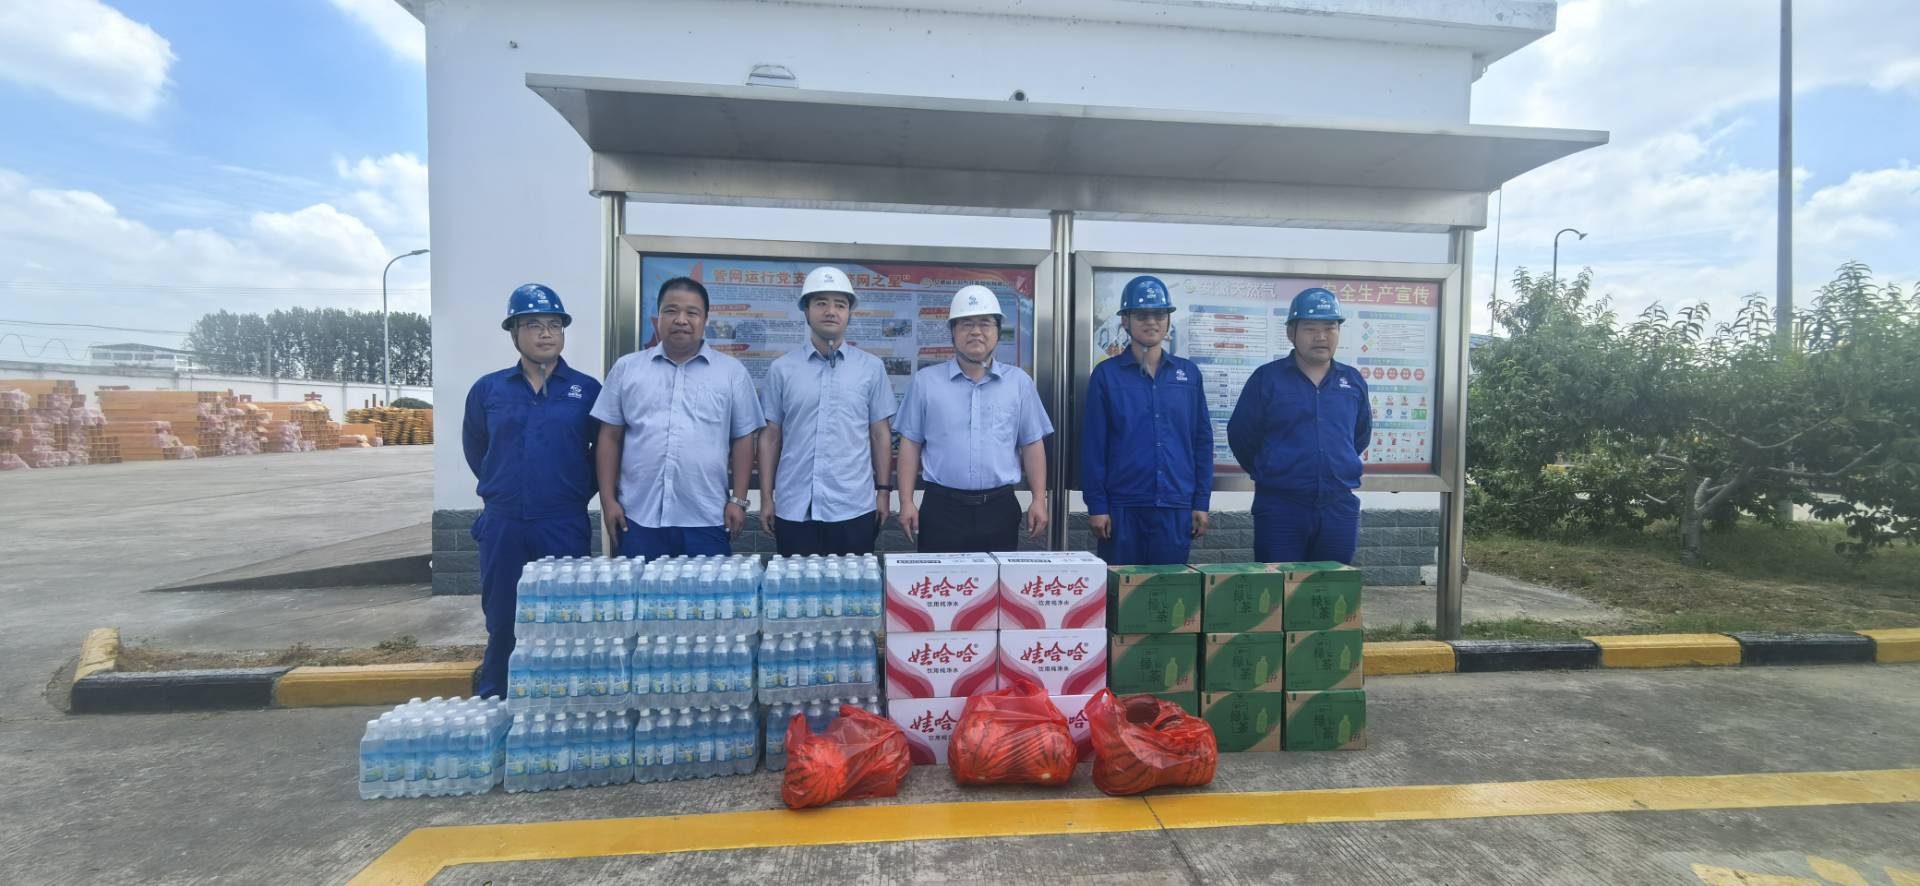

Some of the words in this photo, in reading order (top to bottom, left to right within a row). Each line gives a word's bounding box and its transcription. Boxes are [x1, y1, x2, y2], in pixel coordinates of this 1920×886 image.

[908, 576, 979, 599] 娃哈哈
[1020, 575, 1089, 598] 娃哈哈
[908, 642, 979, 665] 娃哈哈
[1020, 641, 1088, 664] 娃哈哈
[910, 710, 959, 733] 娃哈
